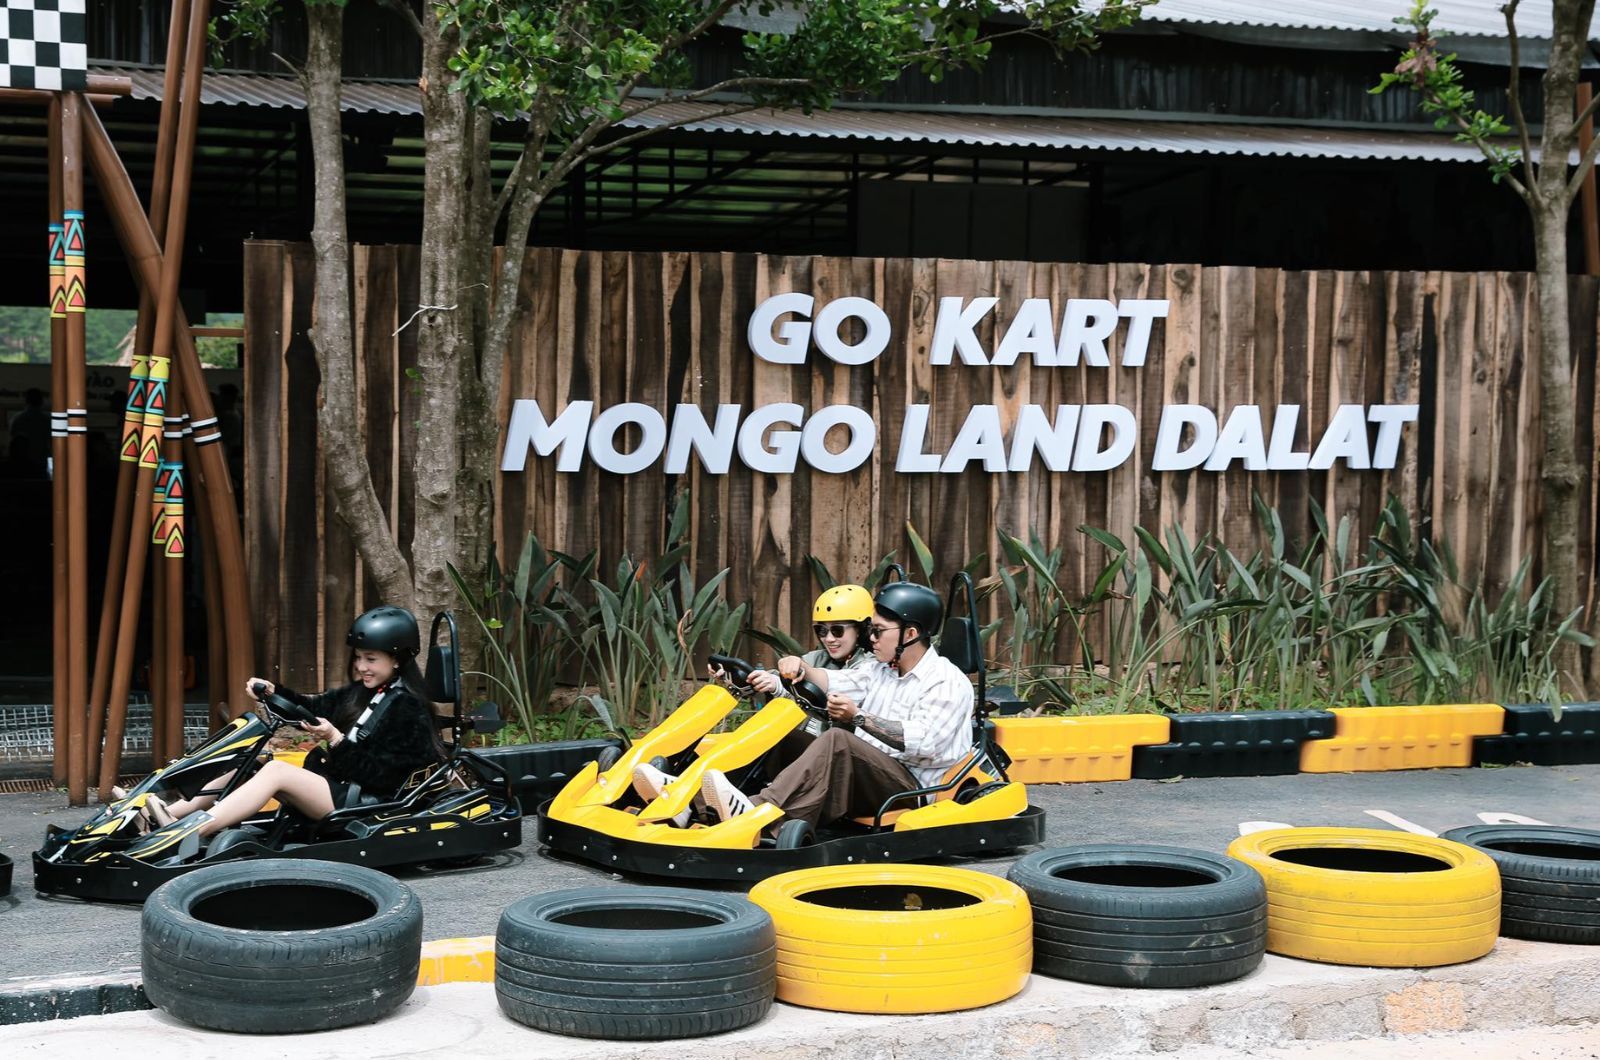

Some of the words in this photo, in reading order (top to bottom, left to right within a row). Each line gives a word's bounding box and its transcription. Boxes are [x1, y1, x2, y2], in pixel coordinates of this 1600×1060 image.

[747, 292, 892, 366] GO
[929, 296, 1170, 367] KART
[500, 399, 876, 474] MONGO
[895, 403, 1137, 473] LAND
[1151, 403, 1420, 472] DALAT
